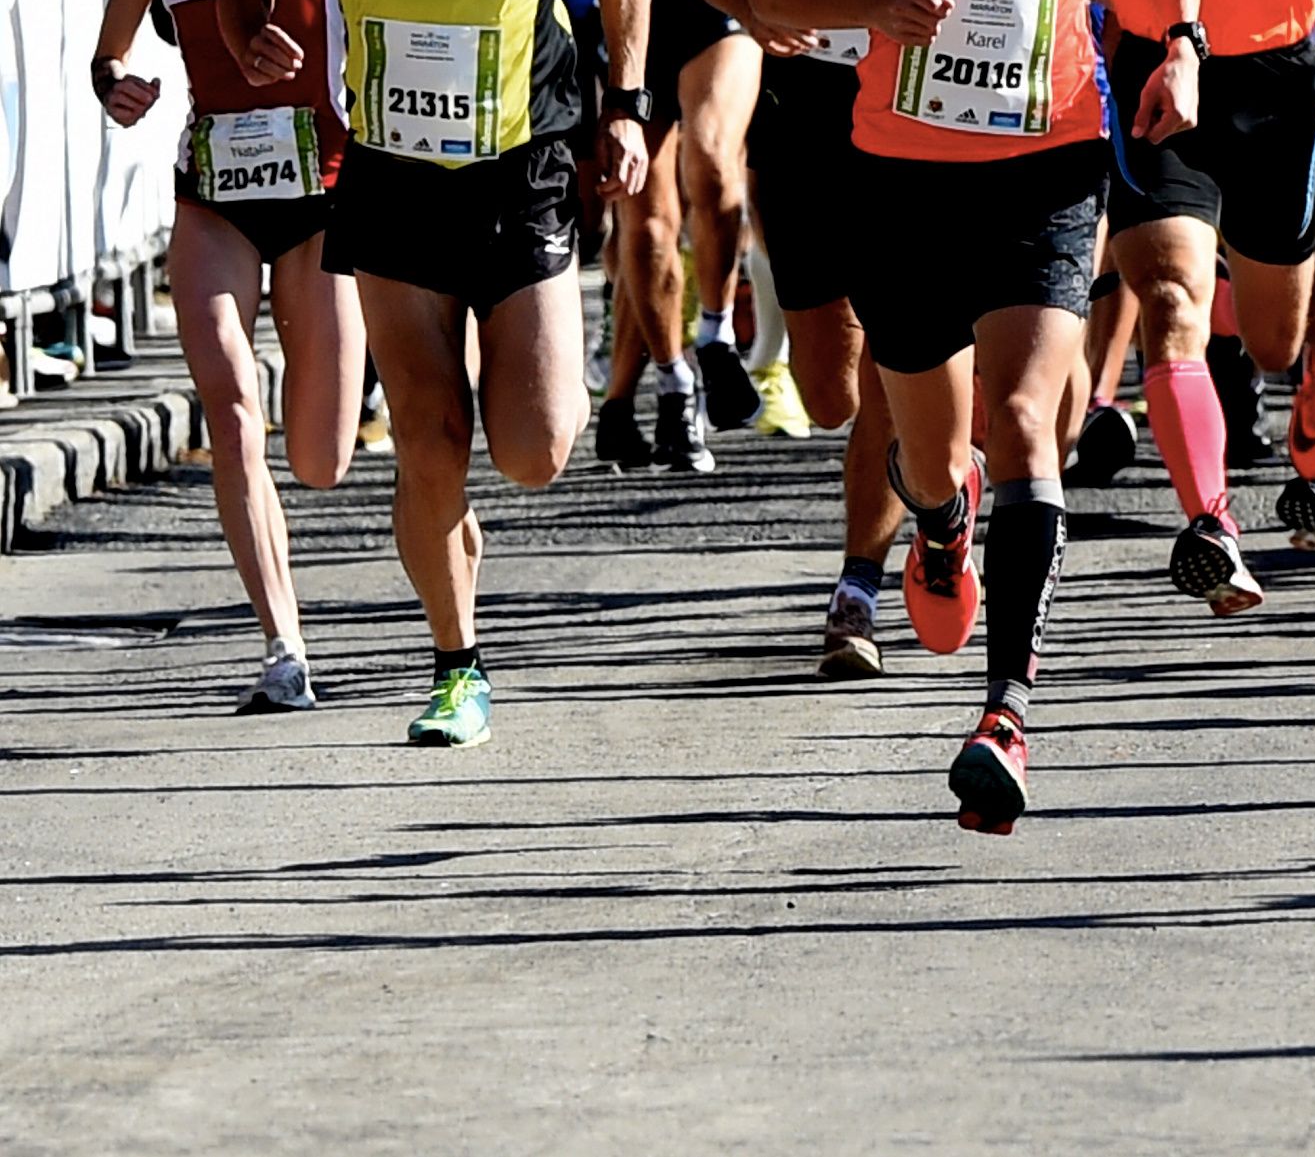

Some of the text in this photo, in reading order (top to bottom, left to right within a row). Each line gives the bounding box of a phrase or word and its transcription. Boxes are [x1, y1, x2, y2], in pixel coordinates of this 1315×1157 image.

[965, 30, 1007, 50] Karel
[931, 53, 1024, 91] 20116
[387, 87, 471, 121] 21315
[217, 158, 298, 192] 20474
